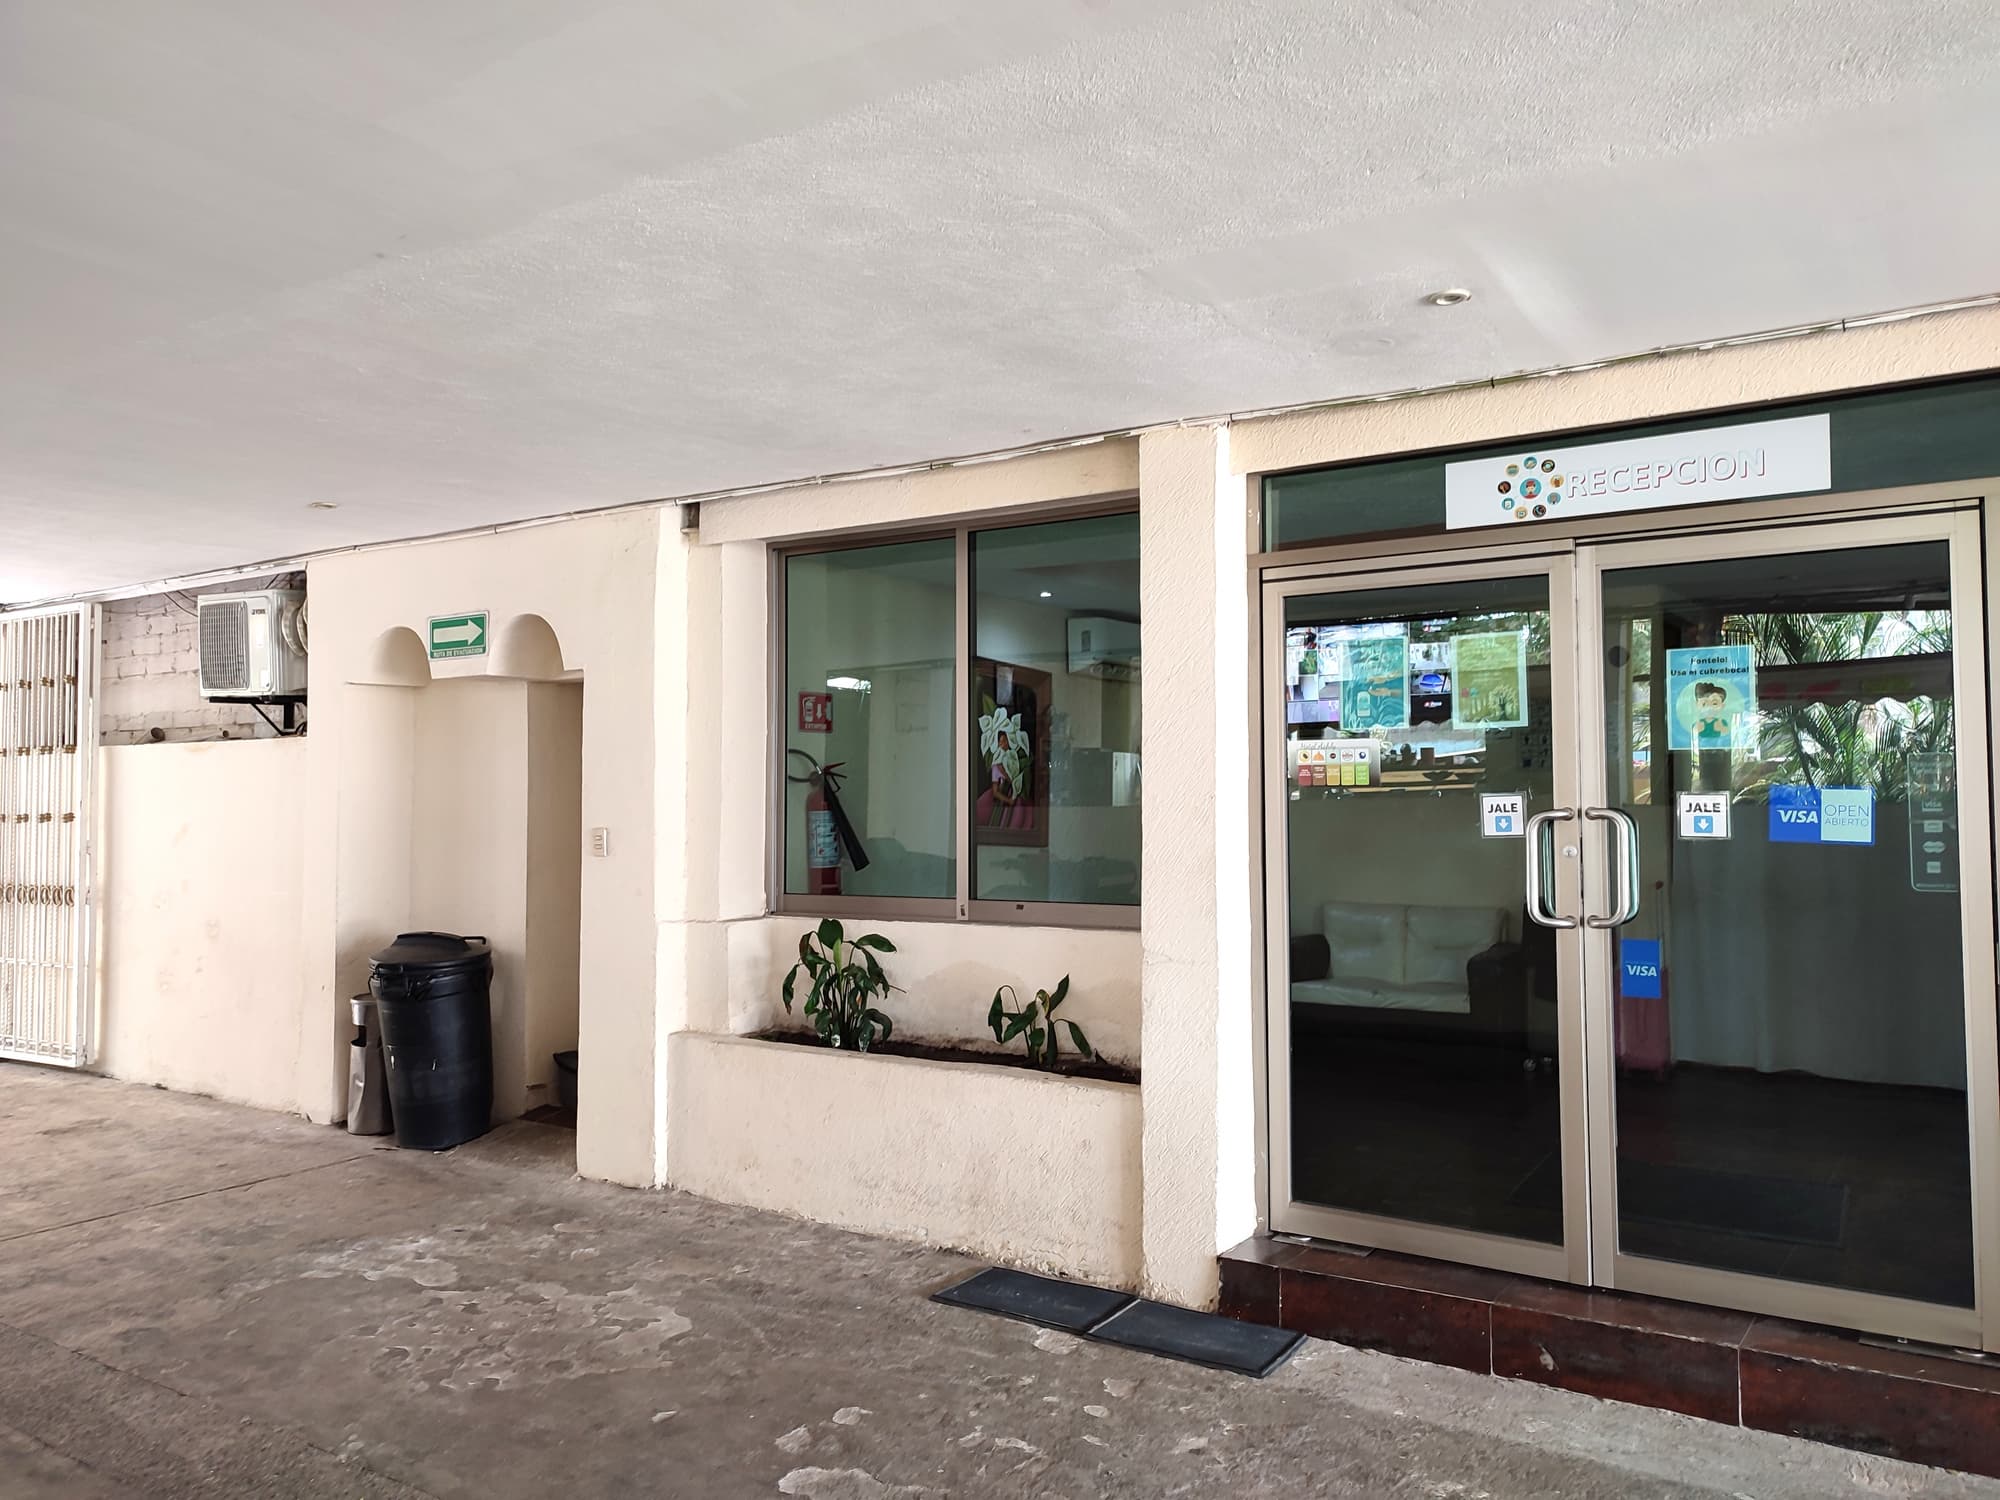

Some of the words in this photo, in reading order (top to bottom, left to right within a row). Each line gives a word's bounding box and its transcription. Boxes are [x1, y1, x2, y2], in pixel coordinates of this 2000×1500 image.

[1567, 448, 1765, 498] RECEPCION
[1670, 669, 1687, 677] Usa
[1487, 802, 1519, 814] JALE
[1685, 802, 1721, 813] JALE
[1824, 804, 1870, 818] OPEN
[1776, 809, 1819, 824] VISA
[1824, 818, 1870, 827] ABIERTO
[1625, 964, 1658, 977] VISA
